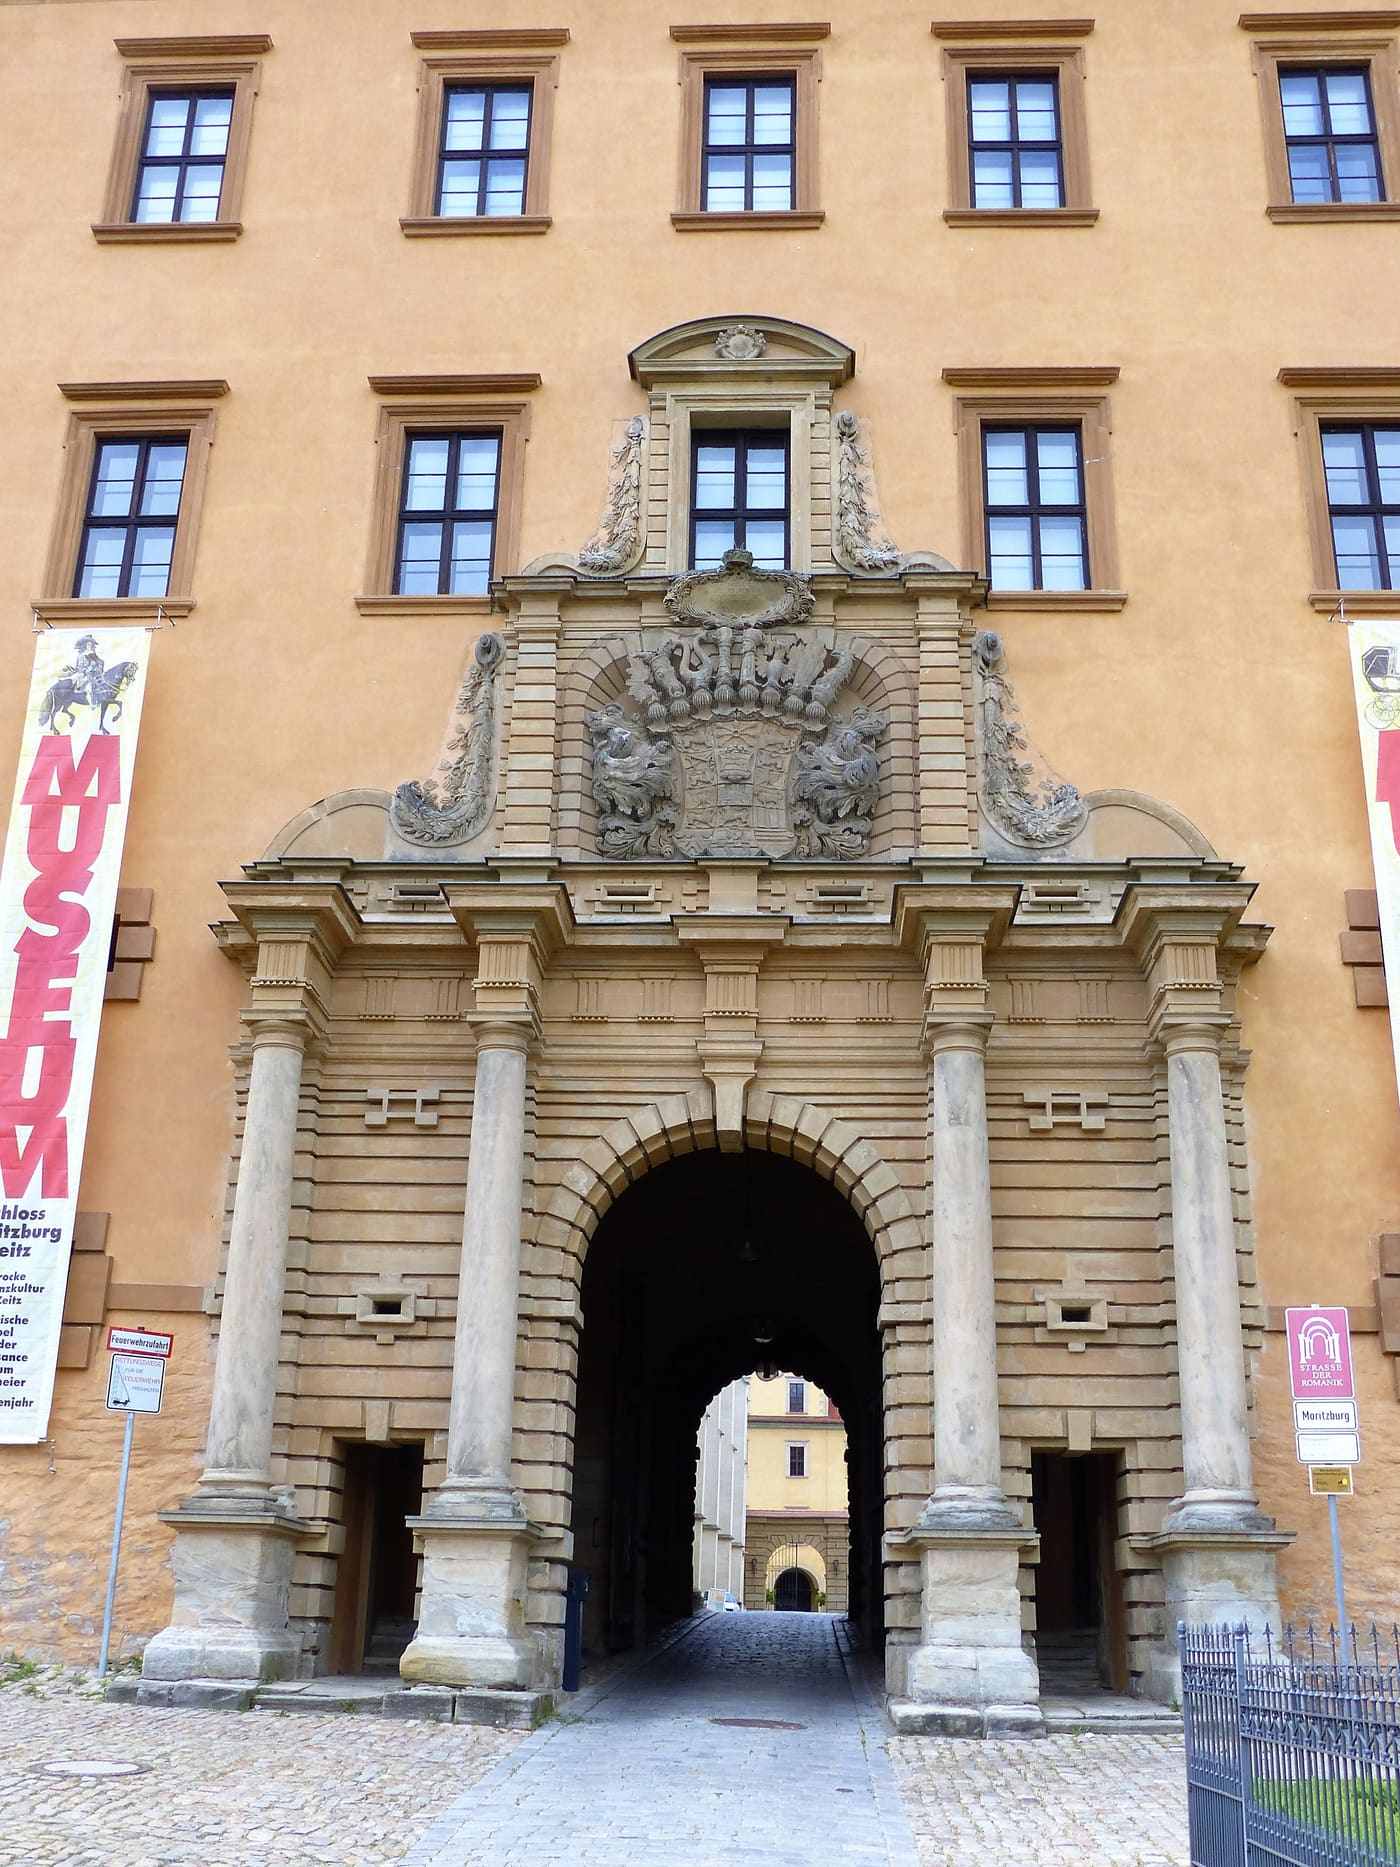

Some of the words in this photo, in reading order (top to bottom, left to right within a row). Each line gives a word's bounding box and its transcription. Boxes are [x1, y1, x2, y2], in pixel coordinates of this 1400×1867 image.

[0, 734, 121, 1199] MUSEUM
[0, 1204, 46, 1220] hloss
[111, 1334, 169, 1350] Feuerwehrzufahrt
[0, 1354, 28, 1362] ance
[1299, 1363, 1343, 1372] STRASSE
[1312, 1371, 1332, 1379] DER
[1301, 1378, 1344, 1387] ROMANIK
[1302, 1410, 1350, 1423] Moritzburg
